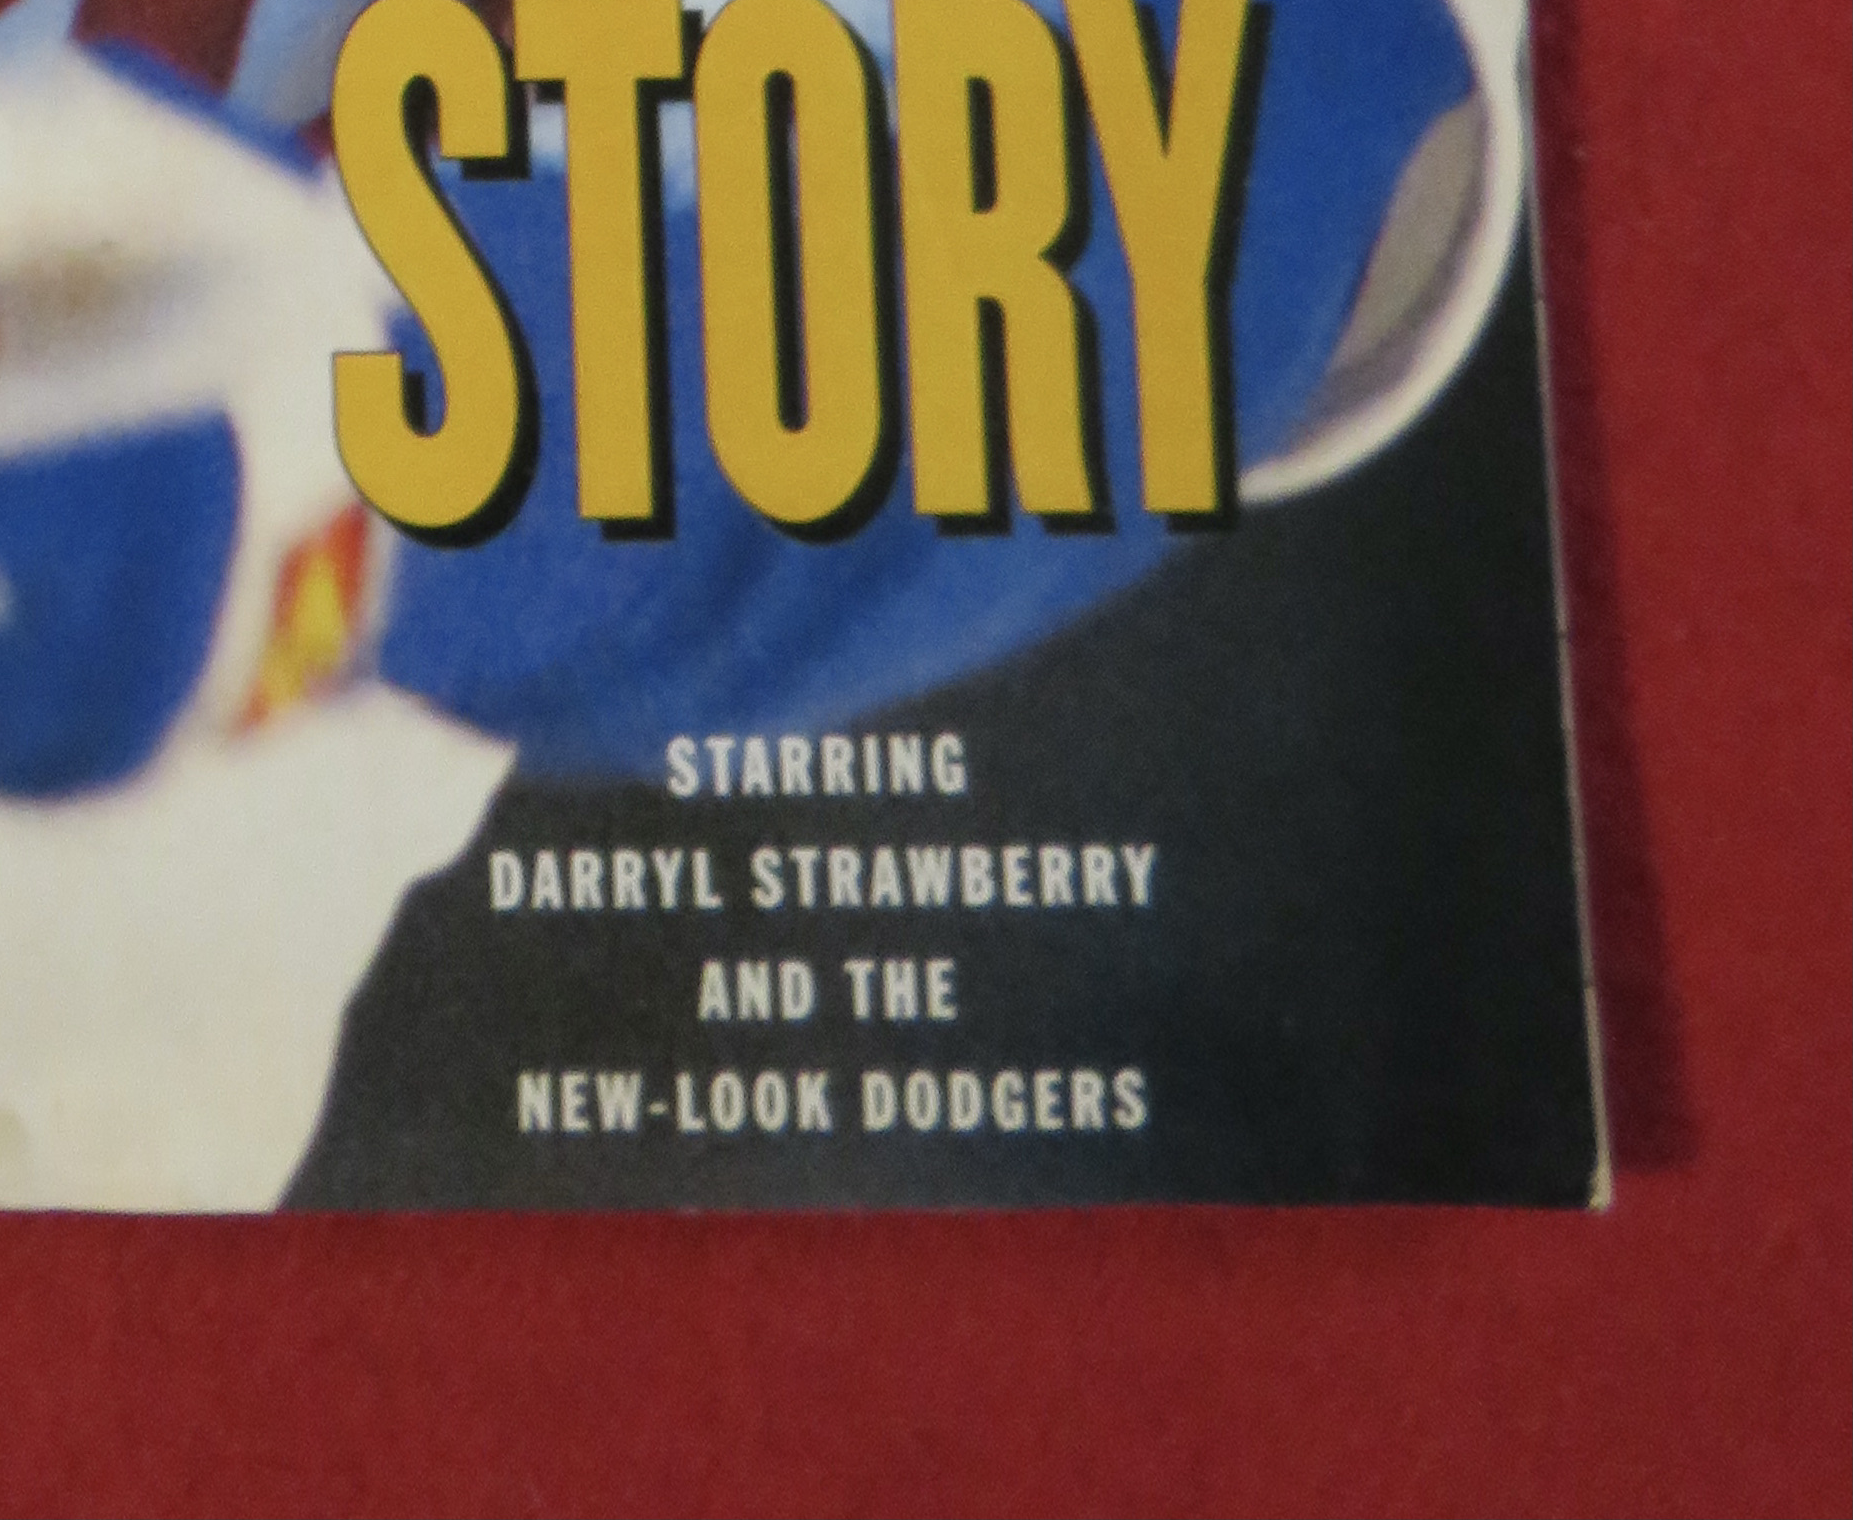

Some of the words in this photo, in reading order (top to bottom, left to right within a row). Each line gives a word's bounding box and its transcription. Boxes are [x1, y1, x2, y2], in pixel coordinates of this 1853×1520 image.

[666, 733, 968, 799] STARRING
[488, 848, 723, 911] DARRYL
[750, 844, 1156, 909] STRAWBERRY
[697, 960, 814, 1021] AND
[844, 959, 959, 1021] THE
[517, 1069, 834, 1132] NEW-LOOK
[861, 1067, 1148, 1131] DODGERS
